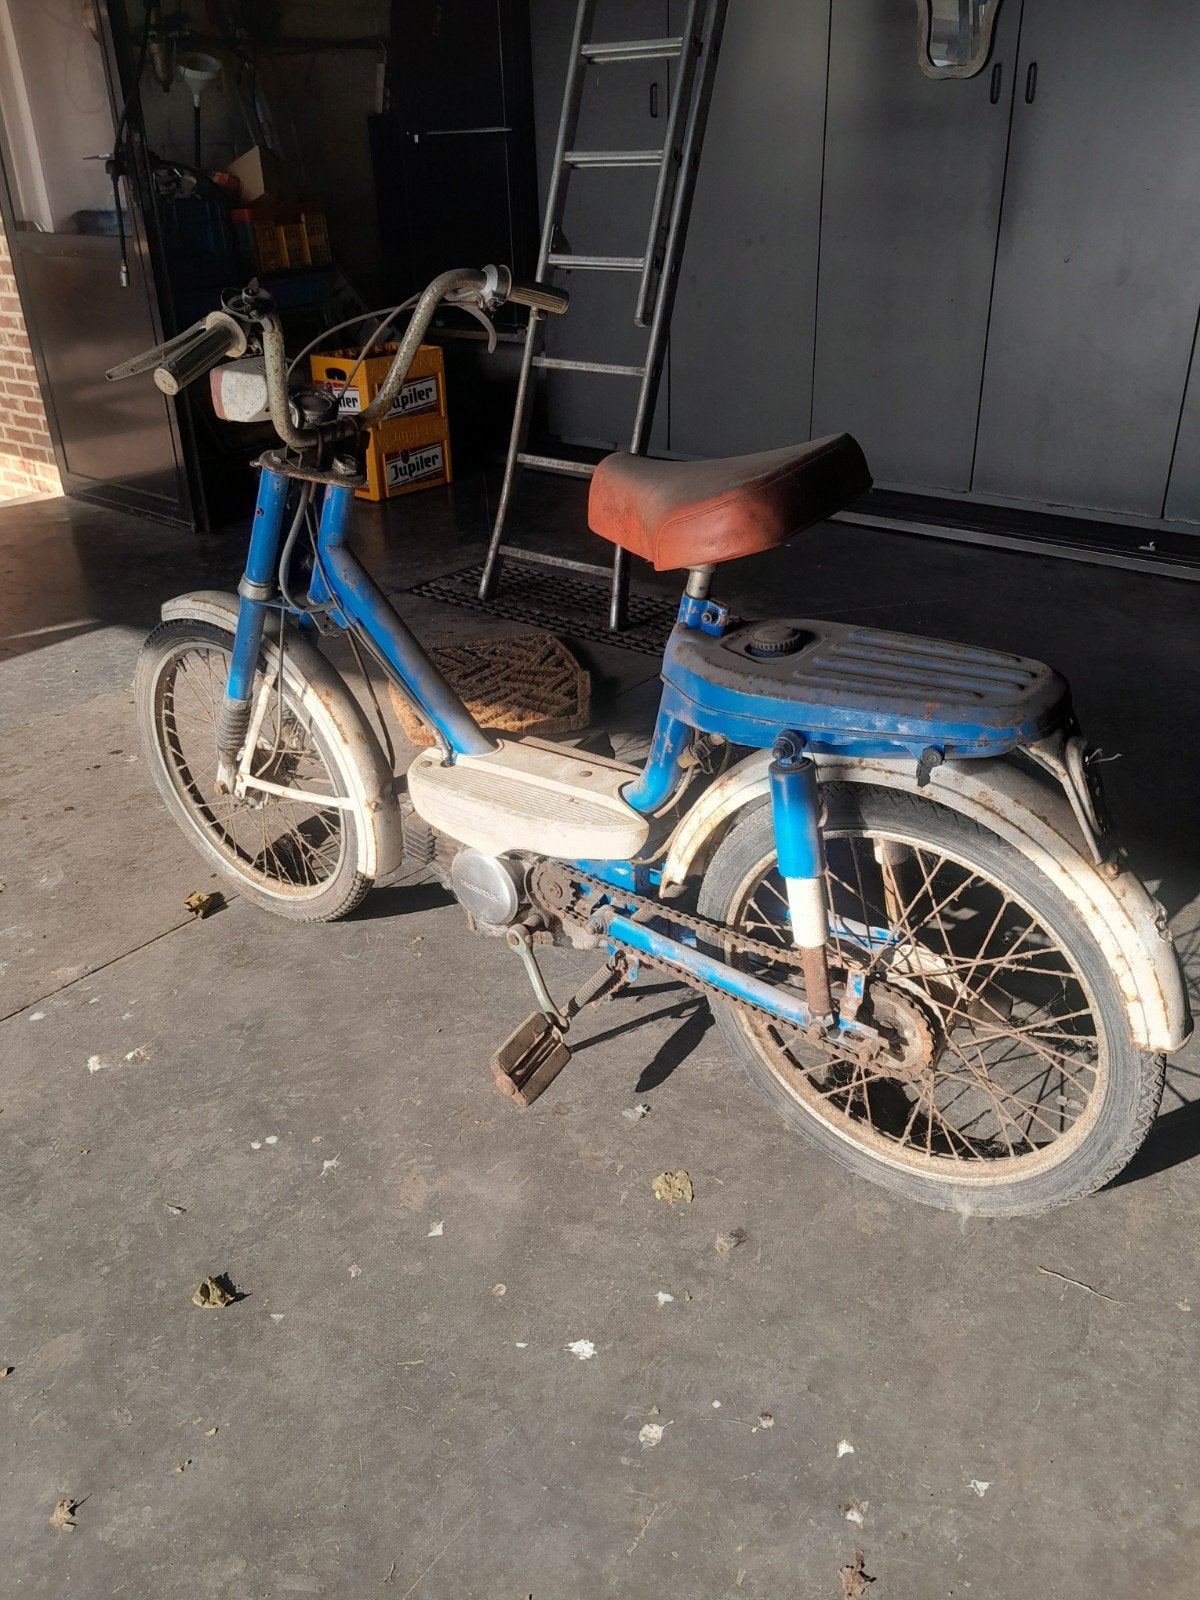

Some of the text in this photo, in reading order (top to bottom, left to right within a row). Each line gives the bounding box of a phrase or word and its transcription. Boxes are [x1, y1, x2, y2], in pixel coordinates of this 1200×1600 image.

[393, 387, 433, 410] upiler
[391, 454, 439, 481] Jupiler
[460, 878, 499, 902] HONDA
